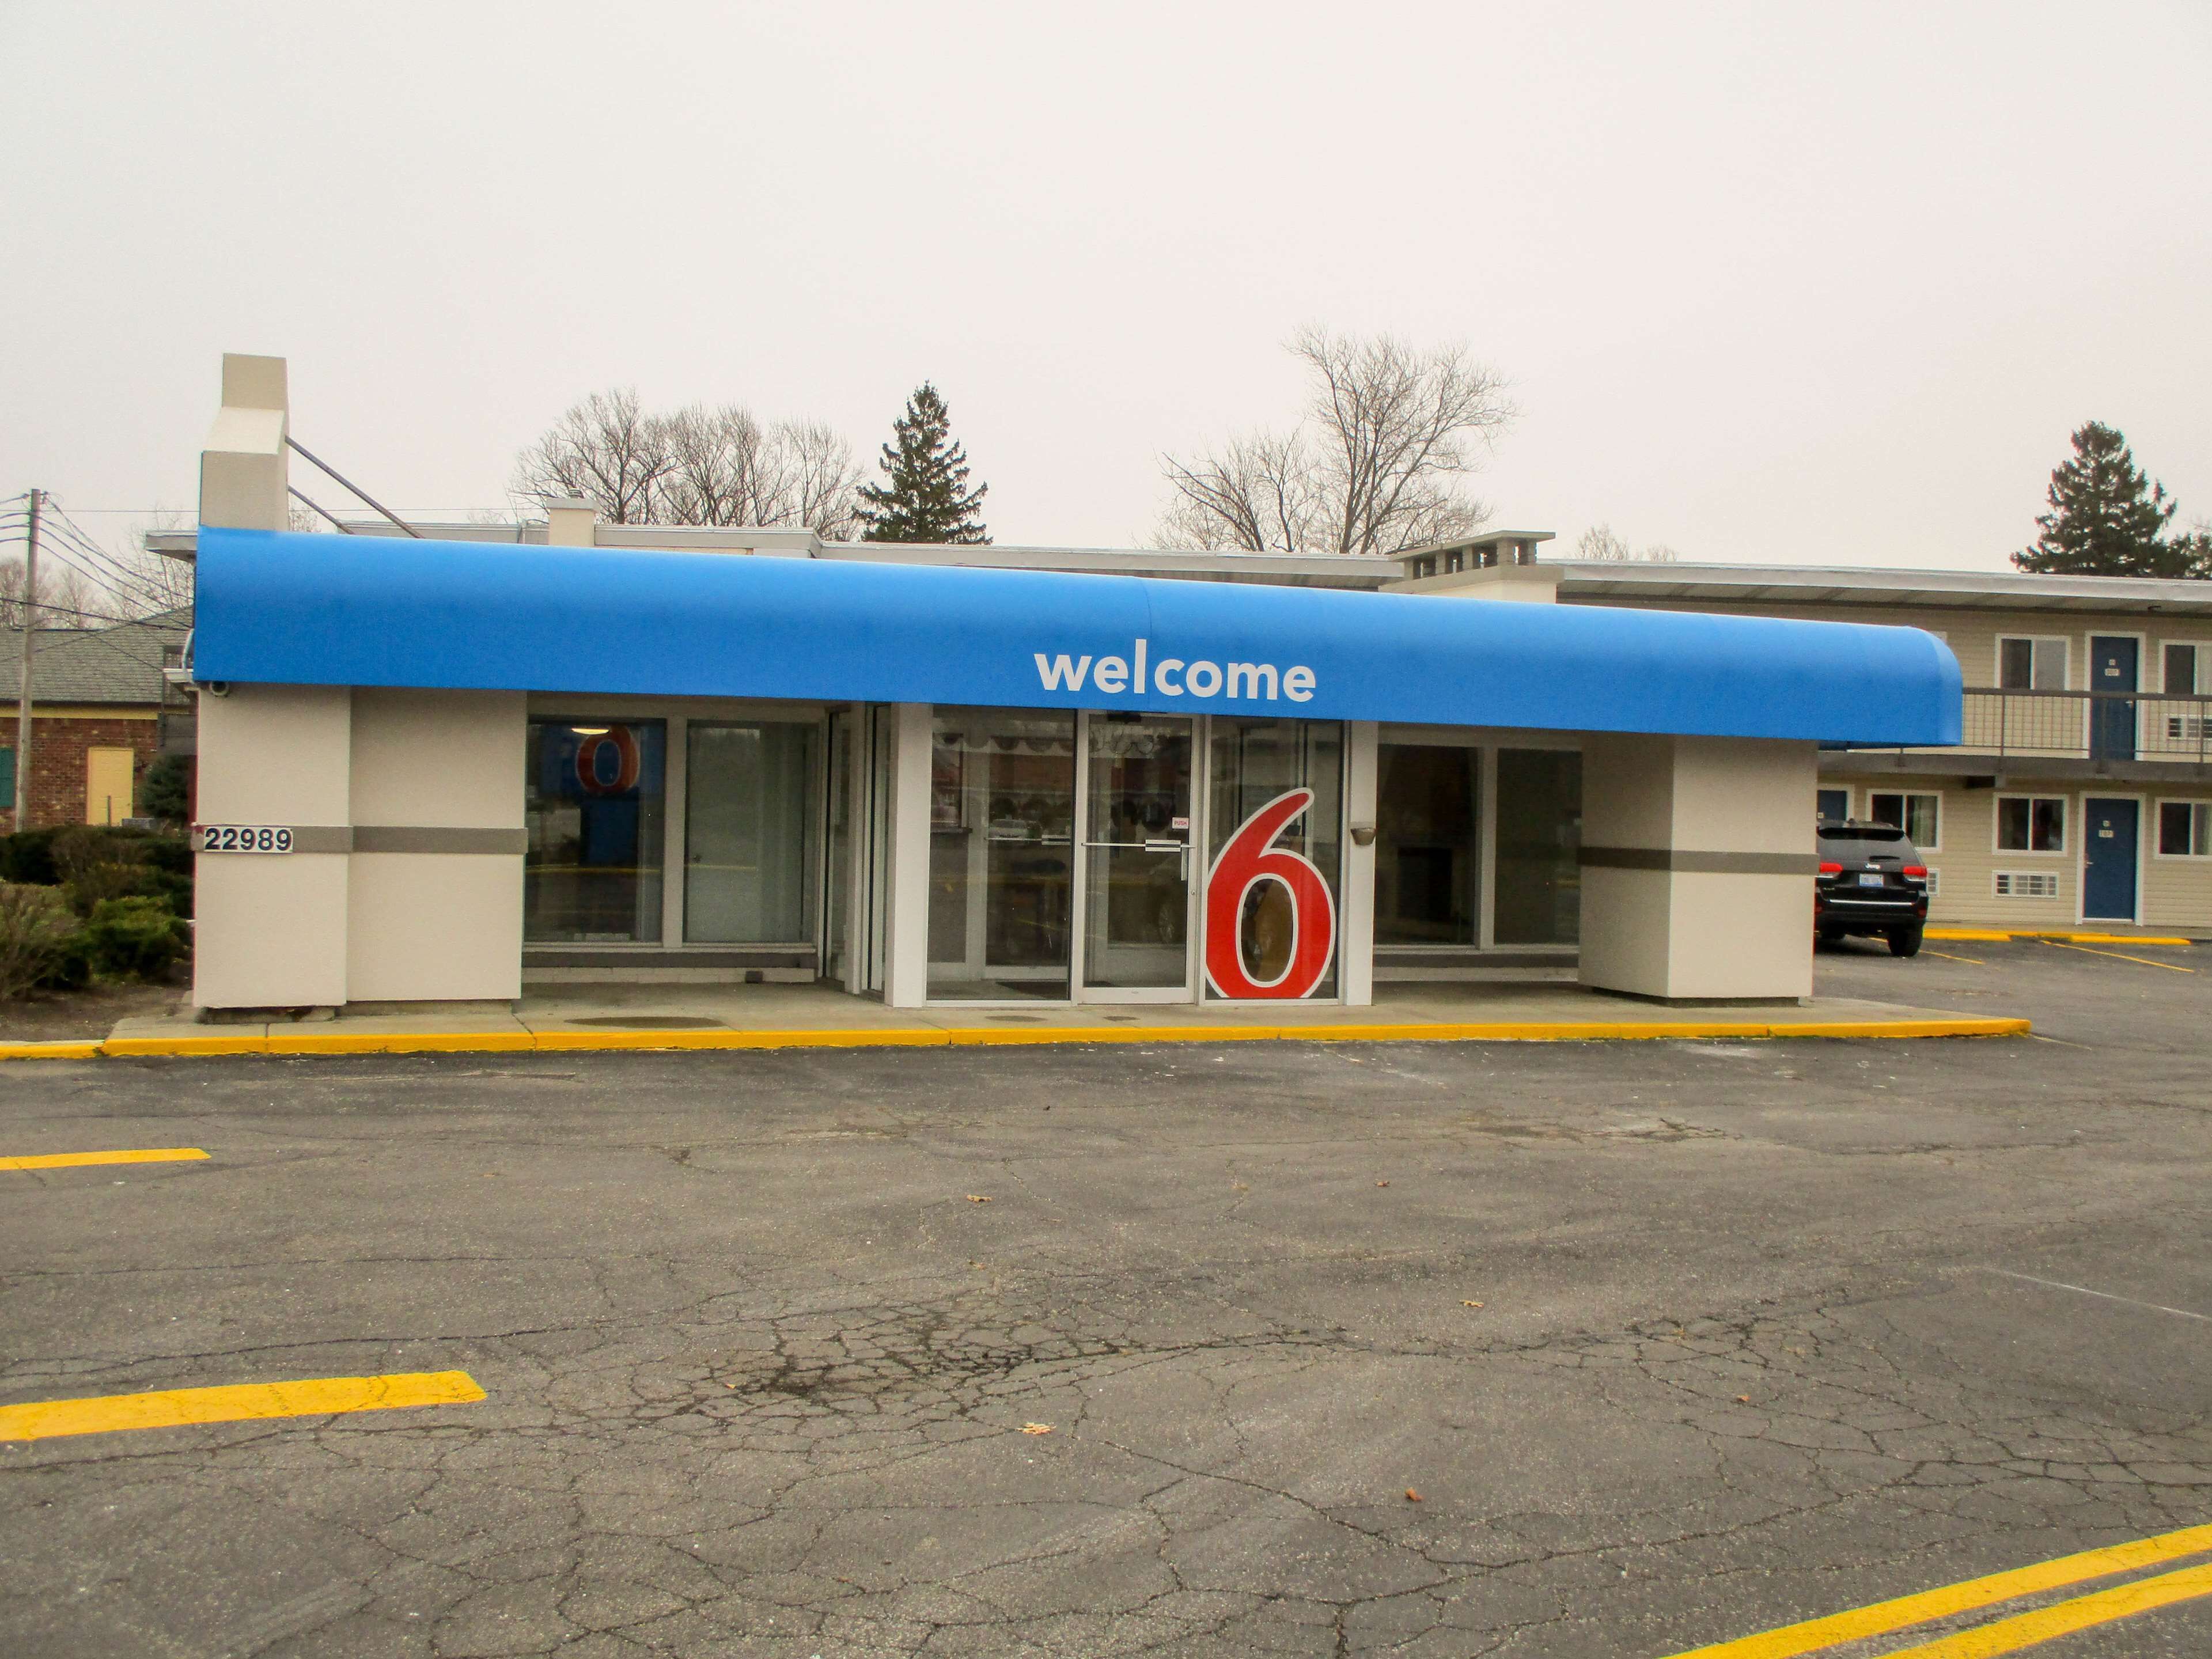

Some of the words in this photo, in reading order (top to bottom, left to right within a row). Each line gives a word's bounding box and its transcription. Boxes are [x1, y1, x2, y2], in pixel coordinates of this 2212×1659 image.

[1034, 639, 1316, 702] welcome
[204, 828, 292, 851] 22989
[1206, 787, 1336, 998] 6
